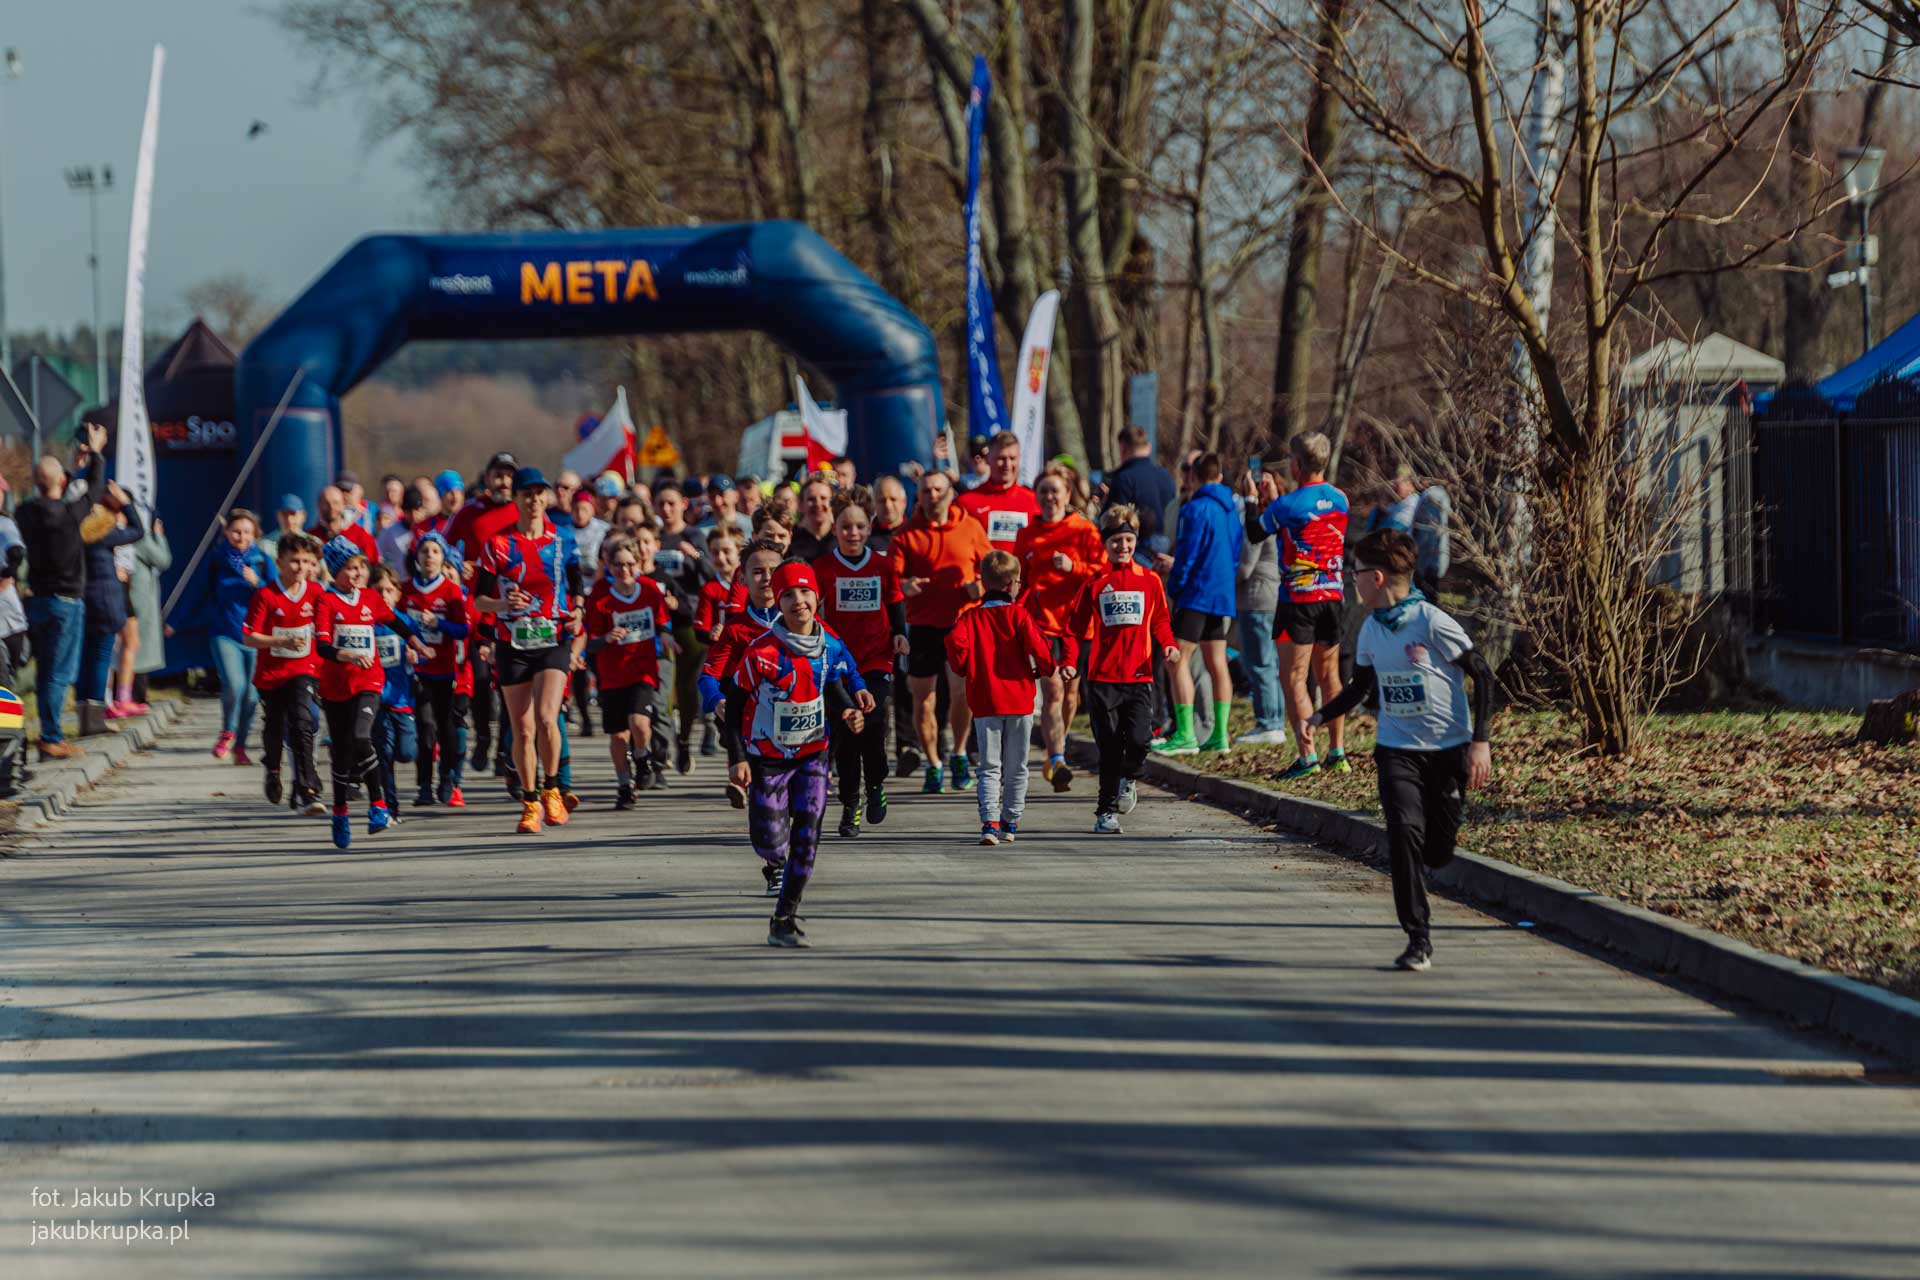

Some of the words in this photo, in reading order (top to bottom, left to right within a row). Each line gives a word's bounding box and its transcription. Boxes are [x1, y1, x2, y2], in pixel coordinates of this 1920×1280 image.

[520, 259, 659, 305] META
[848, 589, 871, 601] 259
[1111, 602, 1134, 614] 235
[343, 636, 367, 649] 244
[1388, 687, 1415, 702] 233
[790, 714, 817, 731] 228
